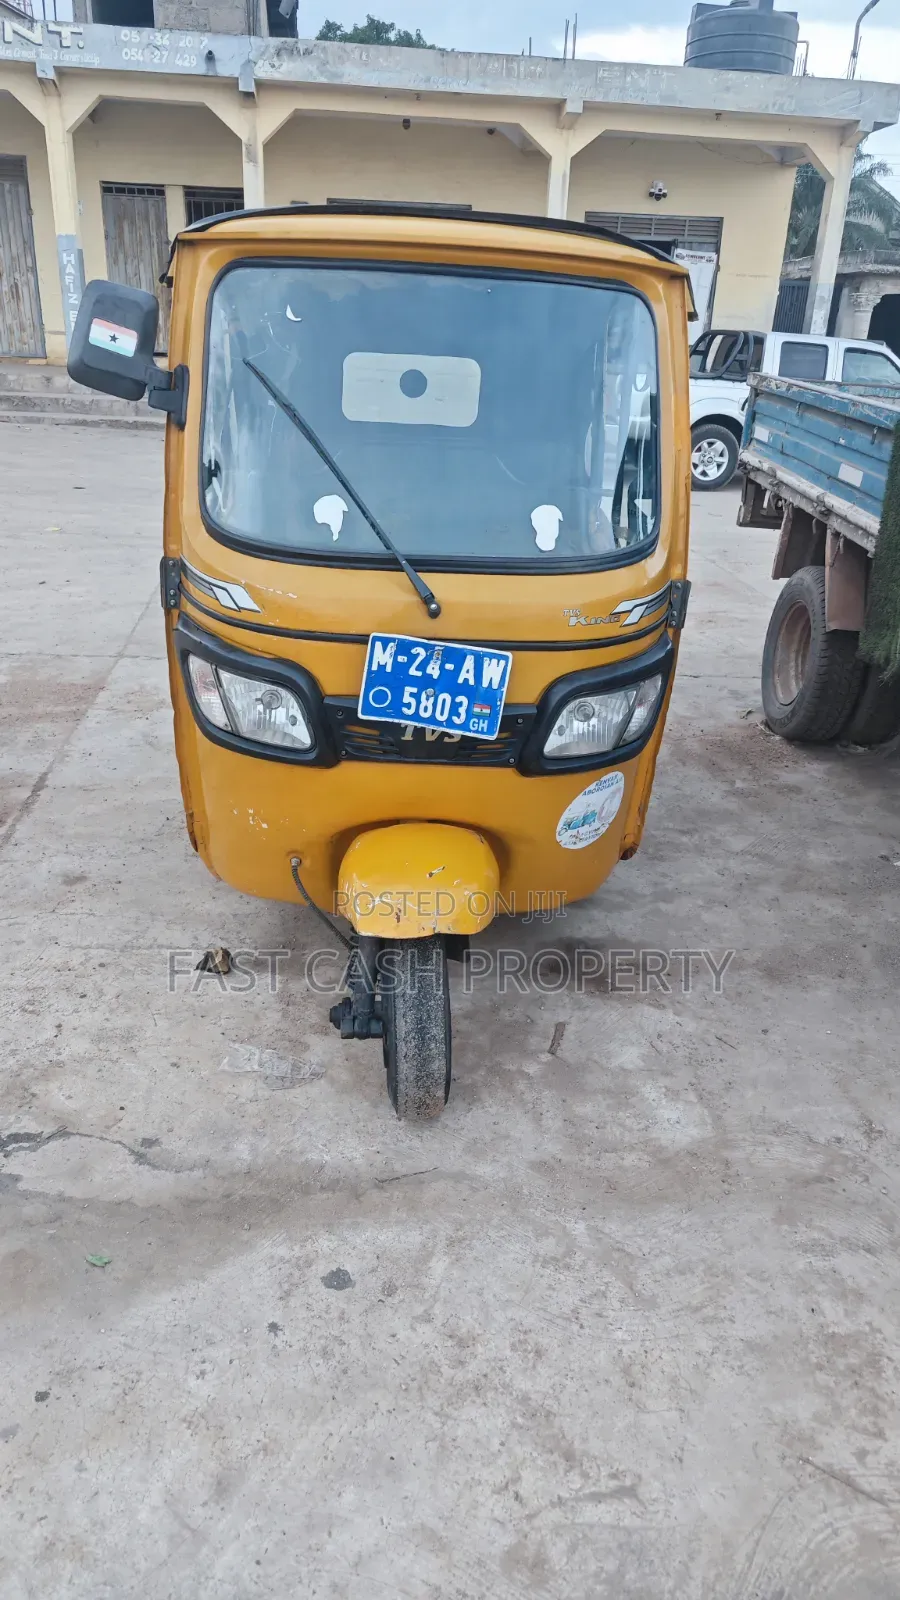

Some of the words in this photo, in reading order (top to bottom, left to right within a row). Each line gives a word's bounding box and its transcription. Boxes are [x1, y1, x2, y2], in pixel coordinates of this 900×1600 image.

[63, 253, 78, 304] HAFIZ
[562, 607, 581, 617] TVS
[371, 640, 506, 690] M-24-AW
[401, 685, 469, 725] 5803
[469, 717, 489, 733] GH
